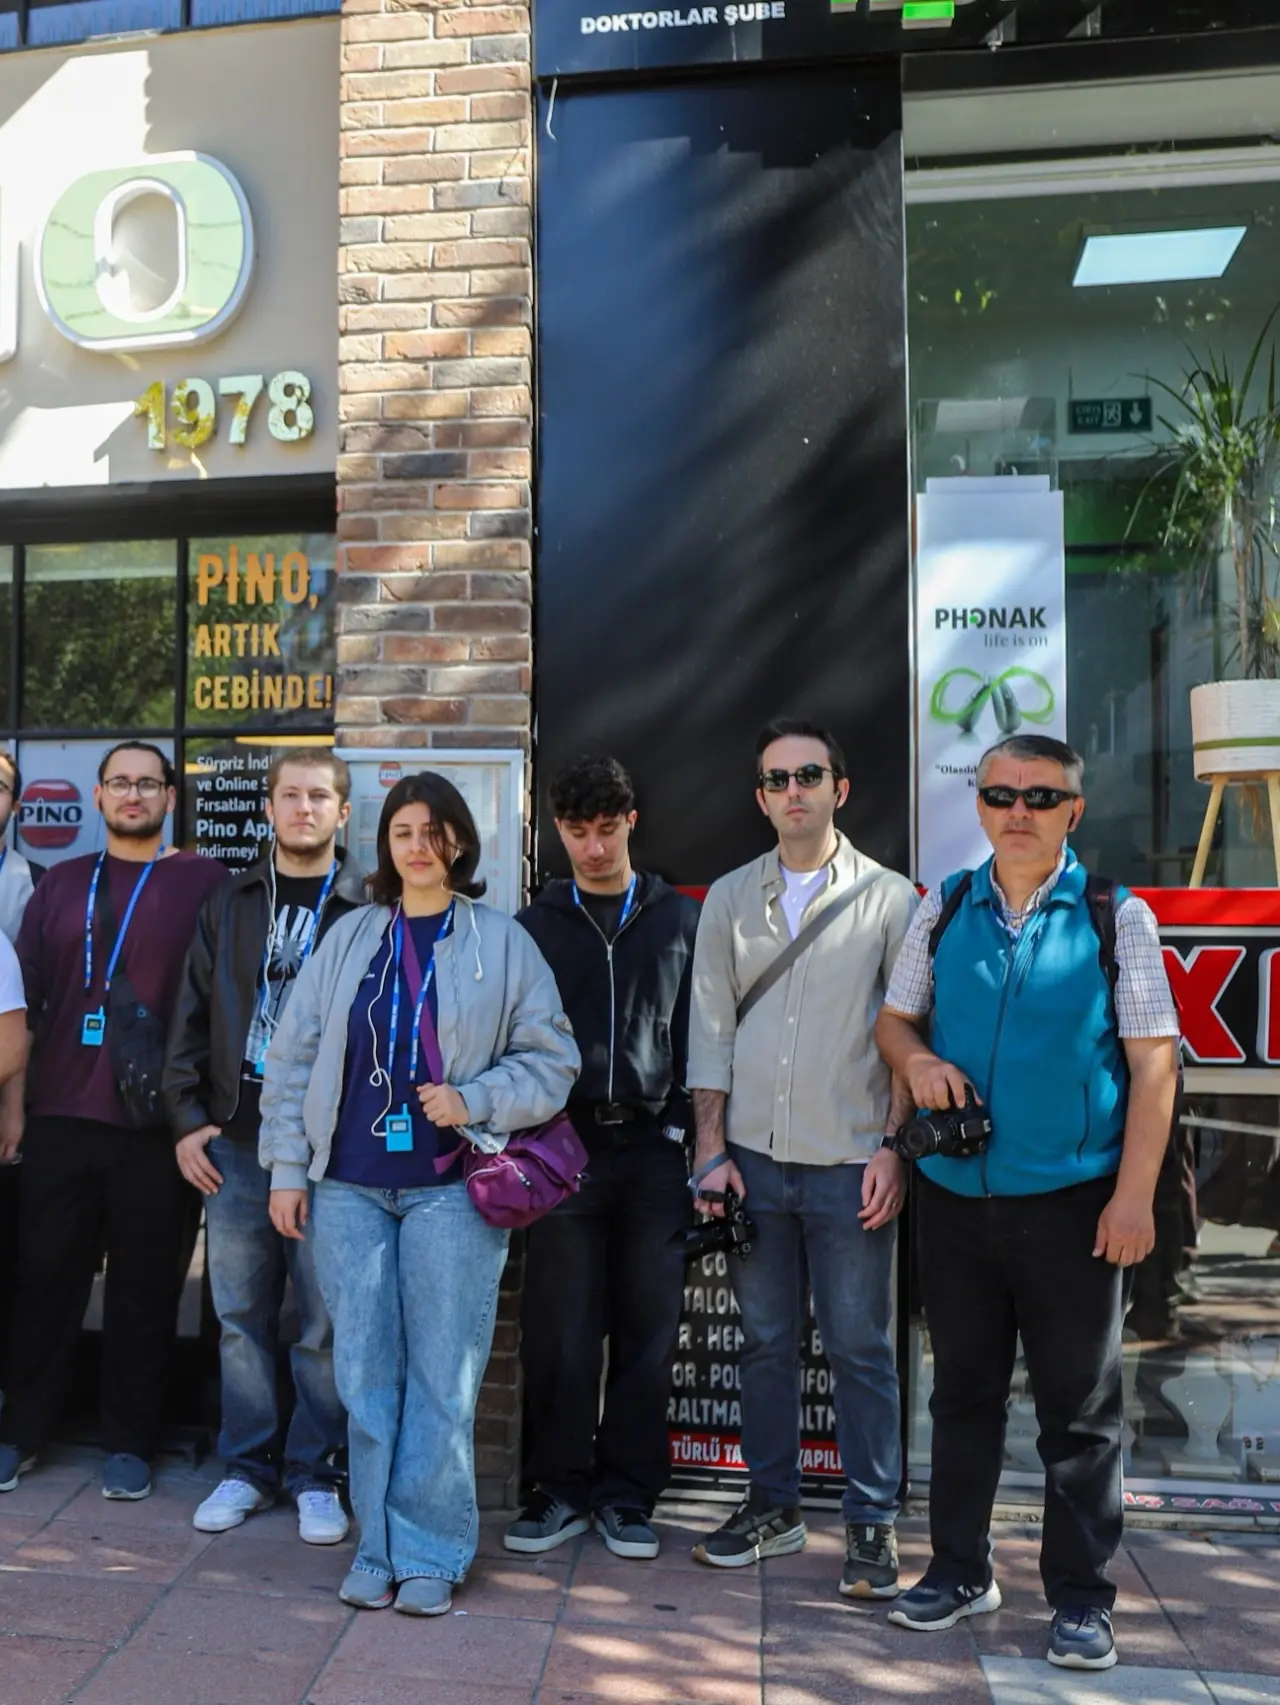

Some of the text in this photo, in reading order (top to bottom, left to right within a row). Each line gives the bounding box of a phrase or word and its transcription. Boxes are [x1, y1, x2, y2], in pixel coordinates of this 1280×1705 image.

[580, 1, 786, 35] DOKTORLAR ŞUBE
[133, 369, 316, 452] 1978
[935, 607, 1048, 630] PHONAK
[195, 623, 281, 658] ARTIK
[984, 633, 1049, 649] life is on
[194, 668, 333, 711] CEBİNDE!
[196, 751, 273, 774] Sürpriz İnd
[196, 779, 212, 792] ve
[215, 776, 259, 793] Online
[196, 797, 256, 813] Fırsatları
[196, 818, 238, 838] Pino
[196, 843, 259, 861] indirmeyi
[672, 1435, 721, 1463] TÜRLÜ
